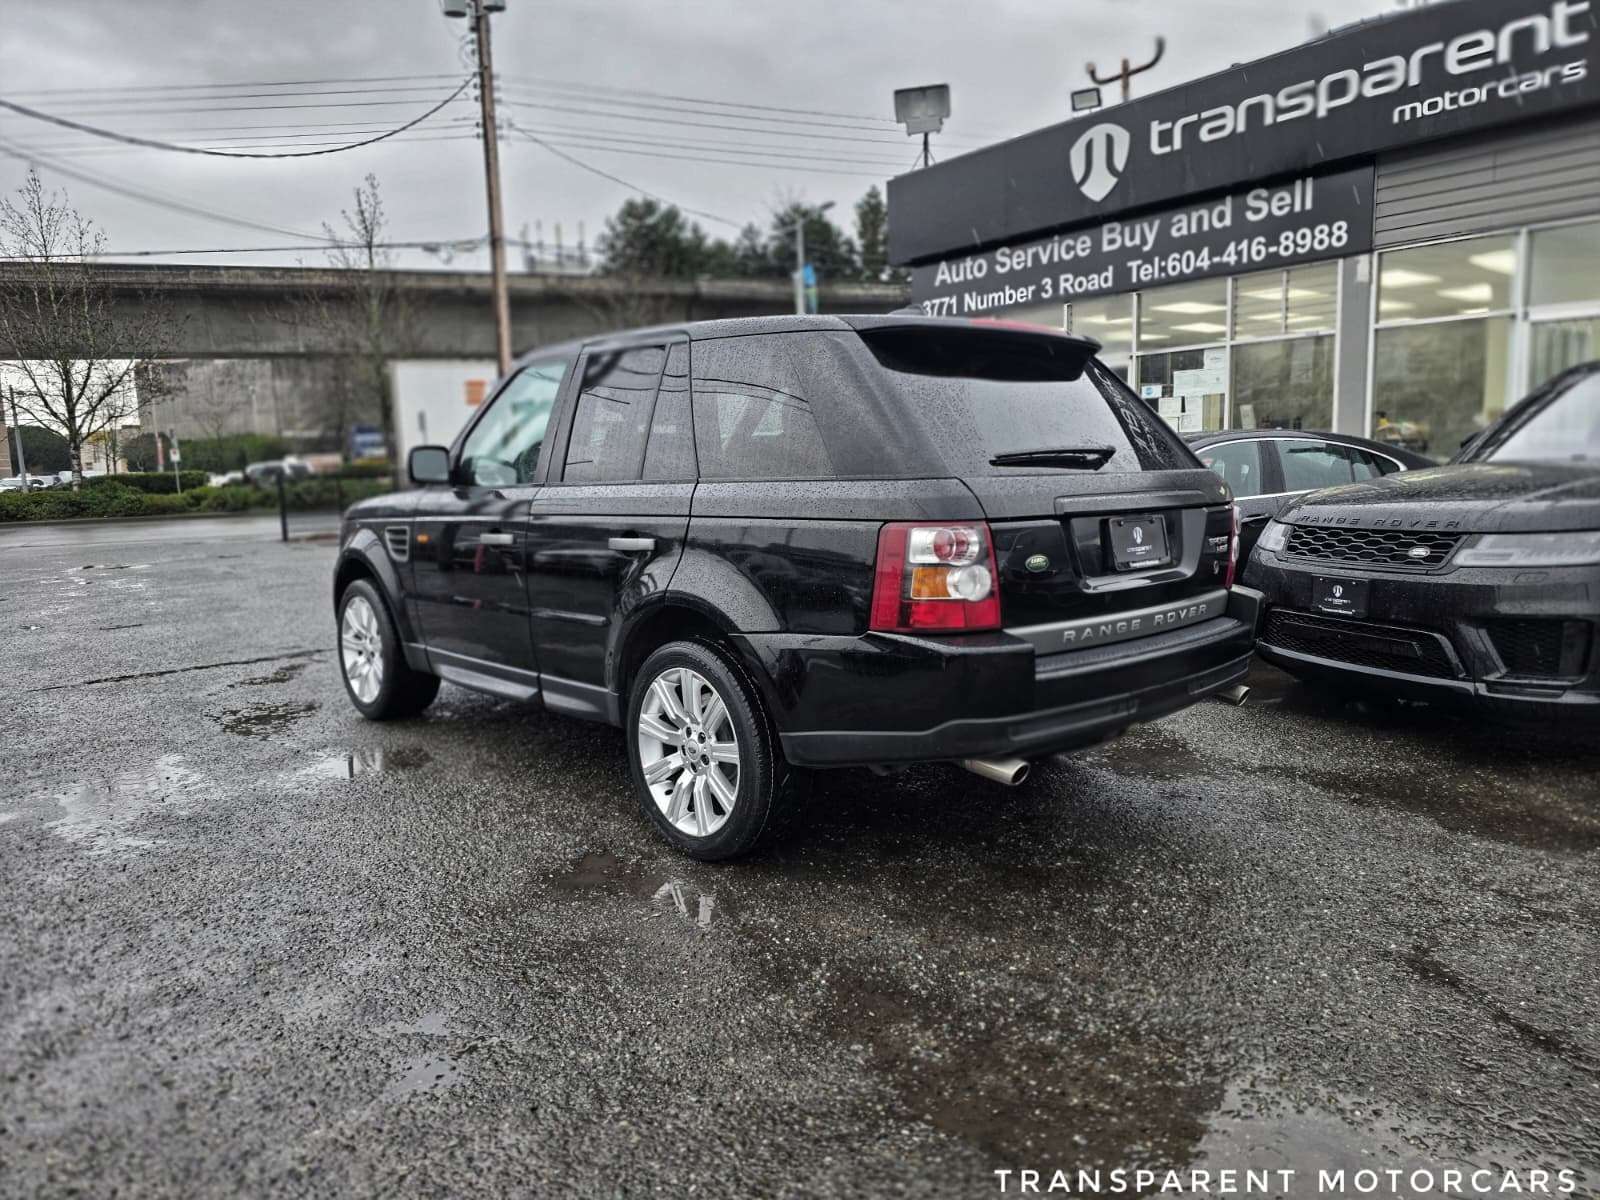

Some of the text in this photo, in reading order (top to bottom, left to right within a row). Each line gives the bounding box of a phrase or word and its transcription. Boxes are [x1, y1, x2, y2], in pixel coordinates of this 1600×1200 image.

[1150, 1, 1590, 156] transparent
[1392, 60, 1587, 124] motorcars
[922, 221, 1349, 318] 3771 Number 3 Road Tel:604-416-8988
[935, 177, 1314, 286] Auto Service Buy and Sell
[1298, 515, 1460, 529] RANGE ROVER
[1063, 604, 1208, 643] RANGE ROVER
